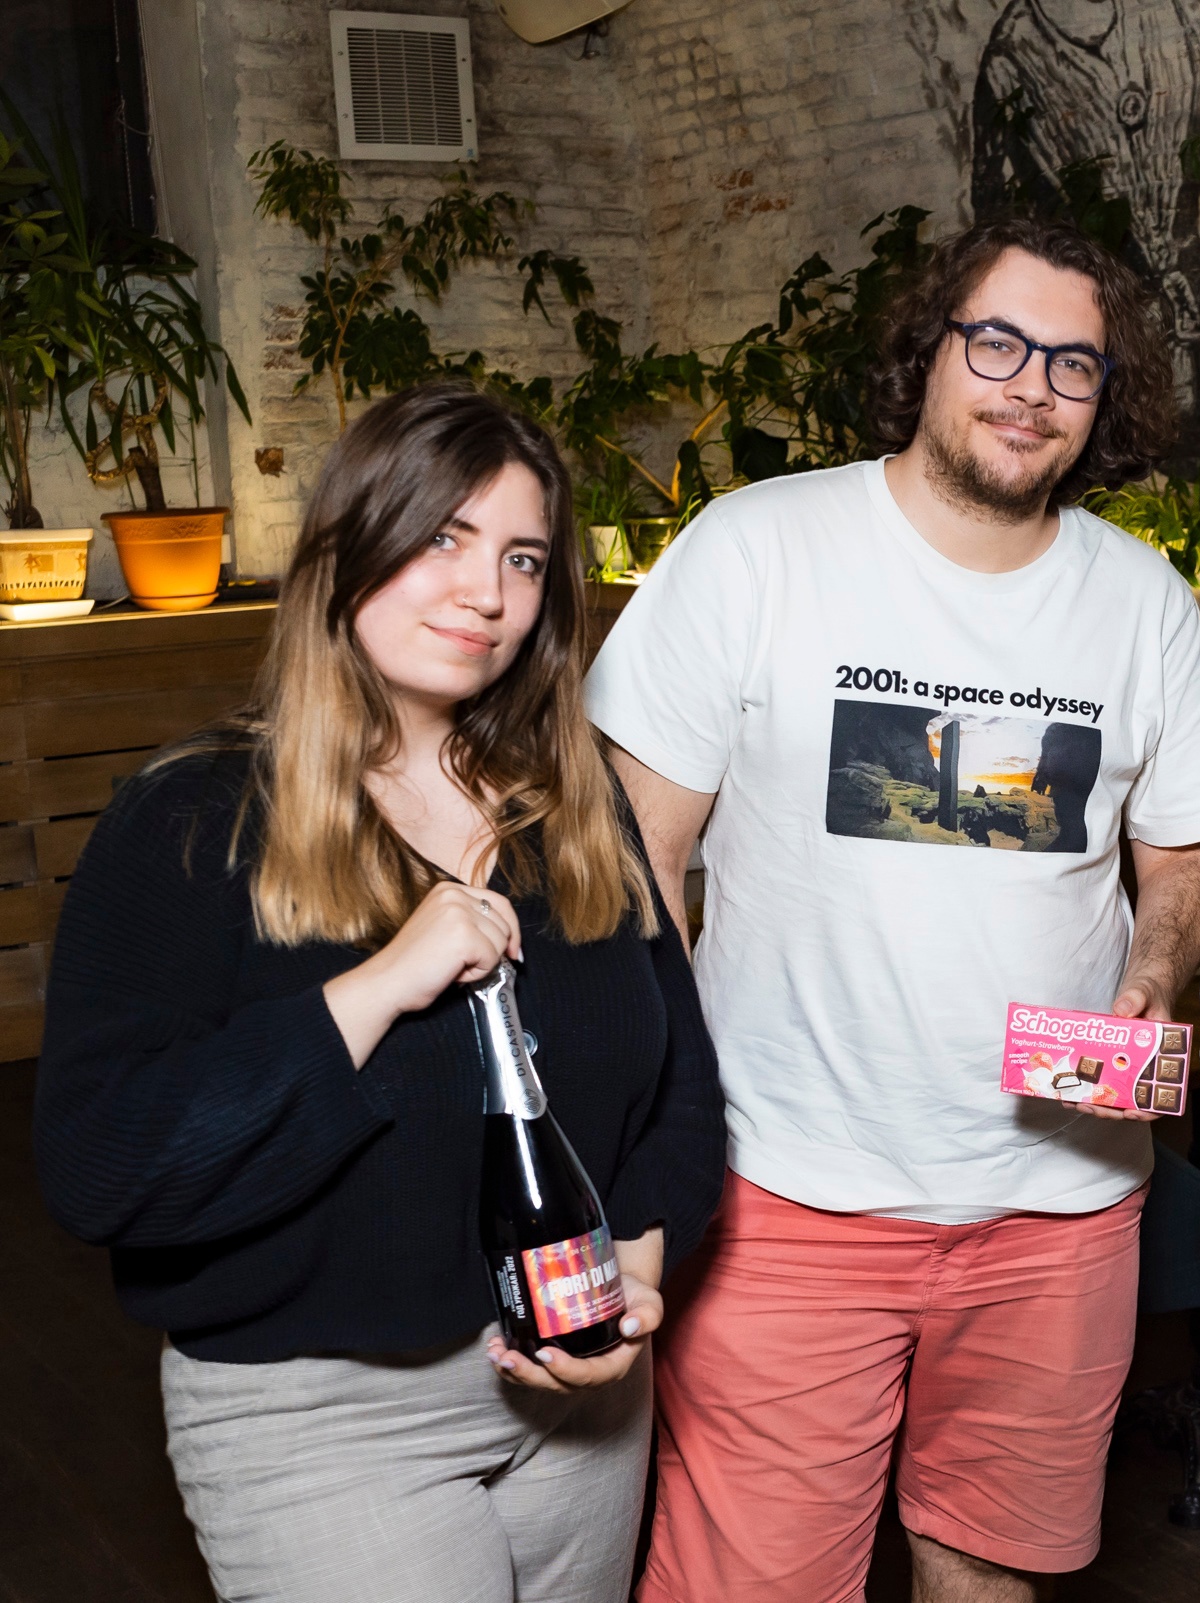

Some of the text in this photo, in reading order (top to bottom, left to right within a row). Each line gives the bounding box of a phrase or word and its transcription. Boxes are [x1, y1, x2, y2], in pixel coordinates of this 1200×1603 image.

[835, 664, 1105, 723] 2001: a space odyssey
[499, 992, 527, 1077] DI CASPICO
[1010, 1008, 1131, 1046] Schogetten
[1011, 1037, 1074, 1053] Yoghurt-Strawberry
[1008, 1051, 1030, 1059] smooth
[1010, 1058, 1028, 1066] recipe
[505, 1255, 516, 1272] 2022
[548, 1271, 590, 1301] FIORI
[590, 1265, 604, 1288] DI
[516, 1303, 526, 1319] ГОД
